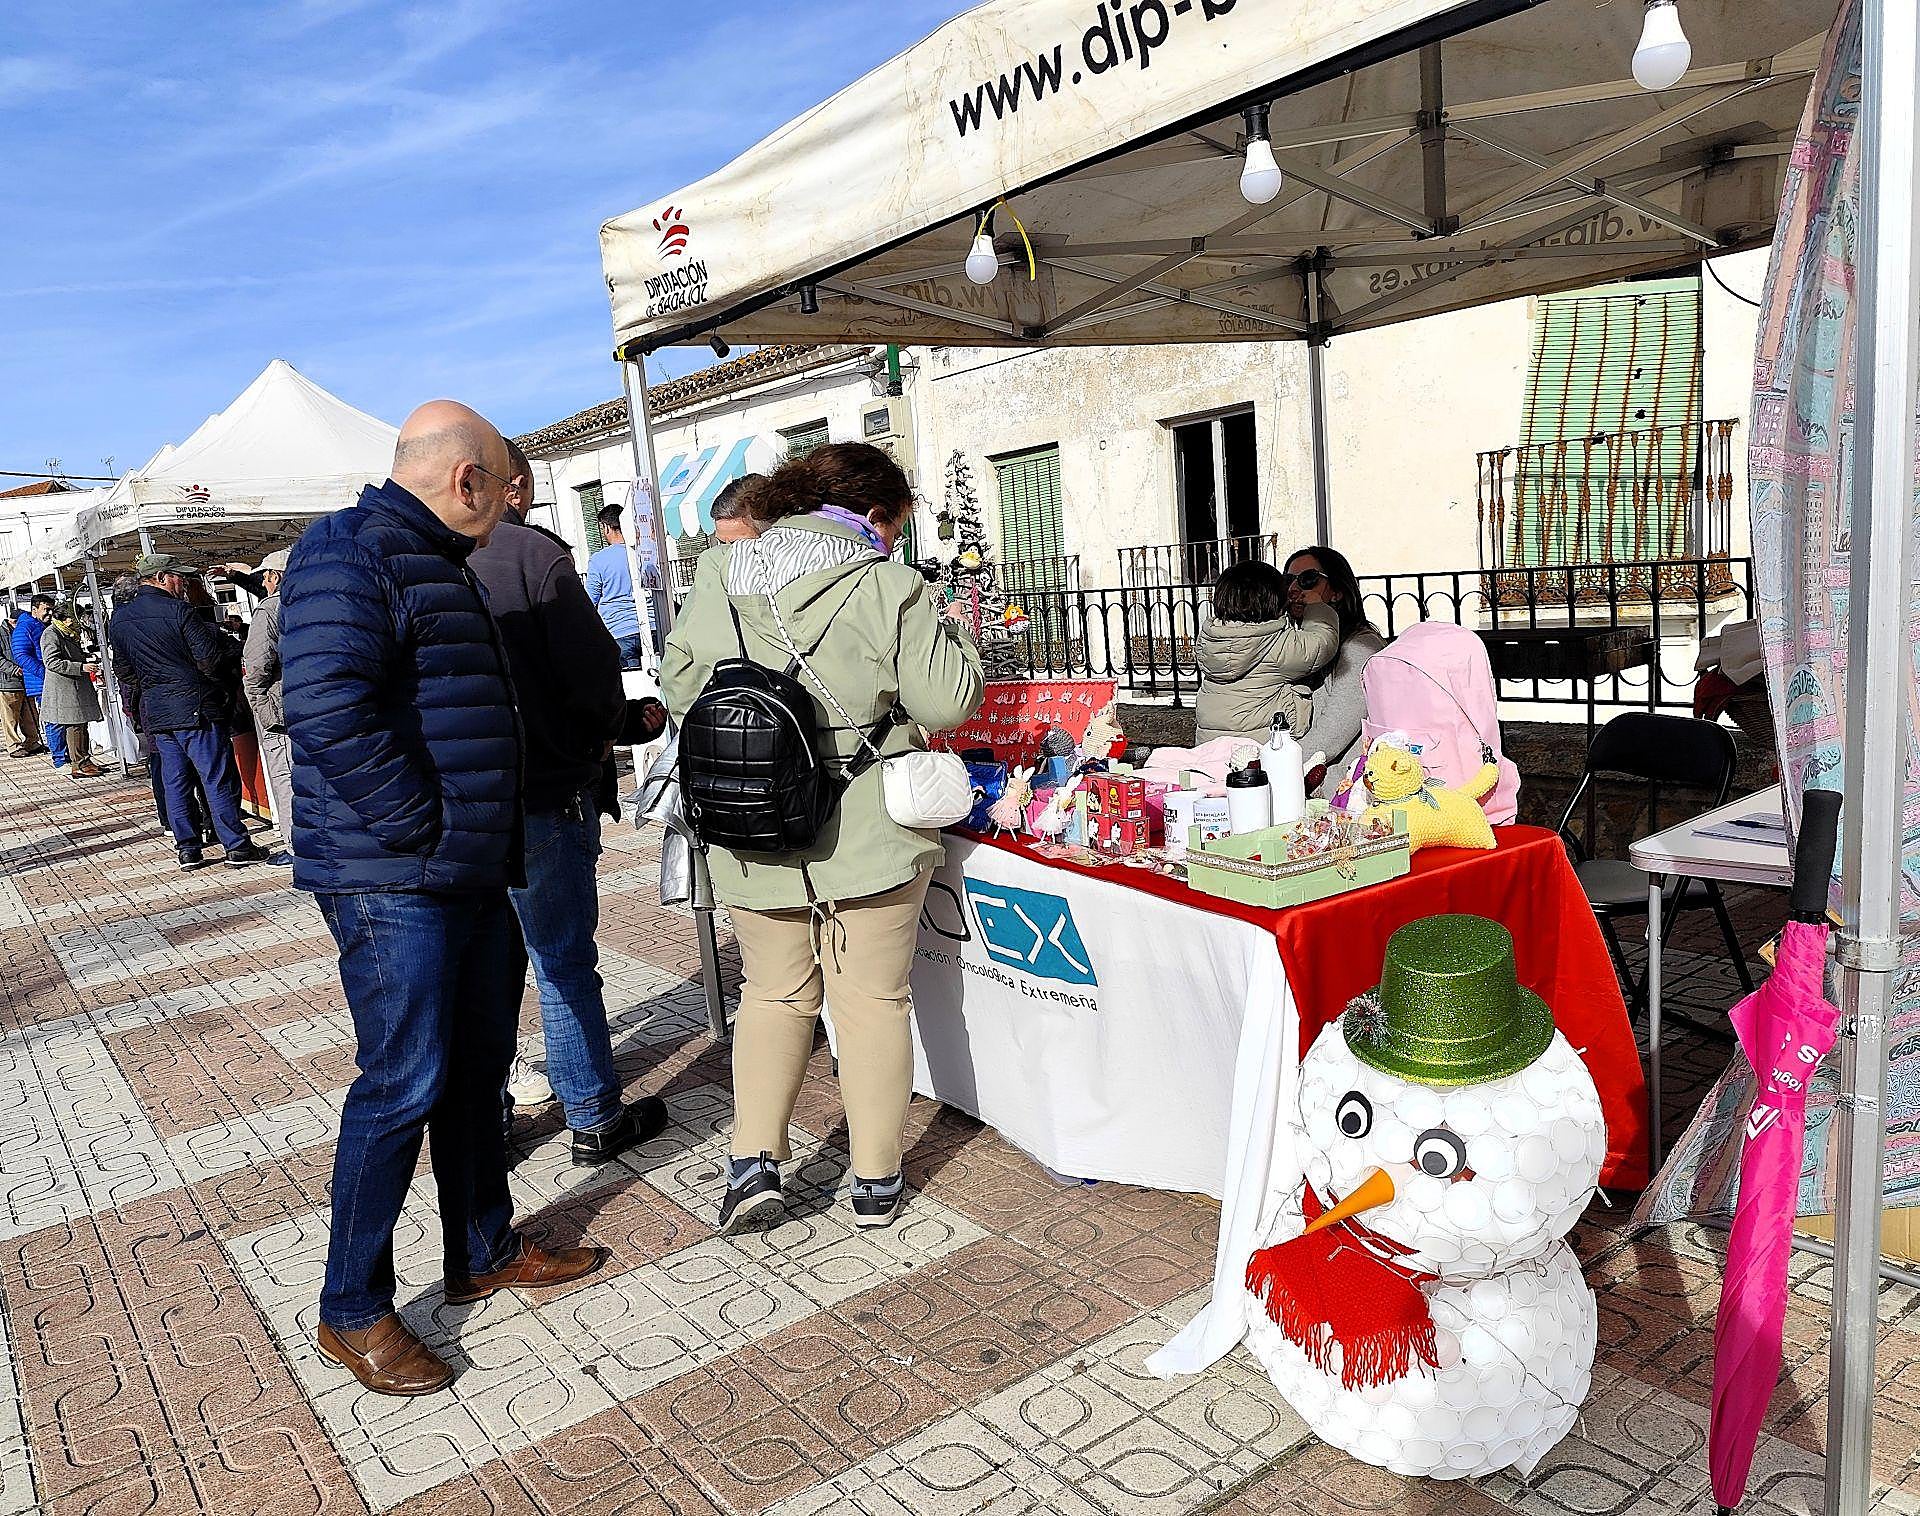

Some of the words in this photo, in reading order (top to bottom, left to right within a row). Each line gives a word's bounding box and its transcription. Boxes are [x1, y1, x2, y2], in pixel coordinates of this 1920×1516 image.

[643, 256, 708, 300] DIPUTACIÓN
[175, 504, 225, 513] DIPUTACIÓN
[186, 511, 226, 519] BADAJOZ
[956, 955, 1015, 989] Oncológica
[1020, 979, 1098, 1012] Extremeña
